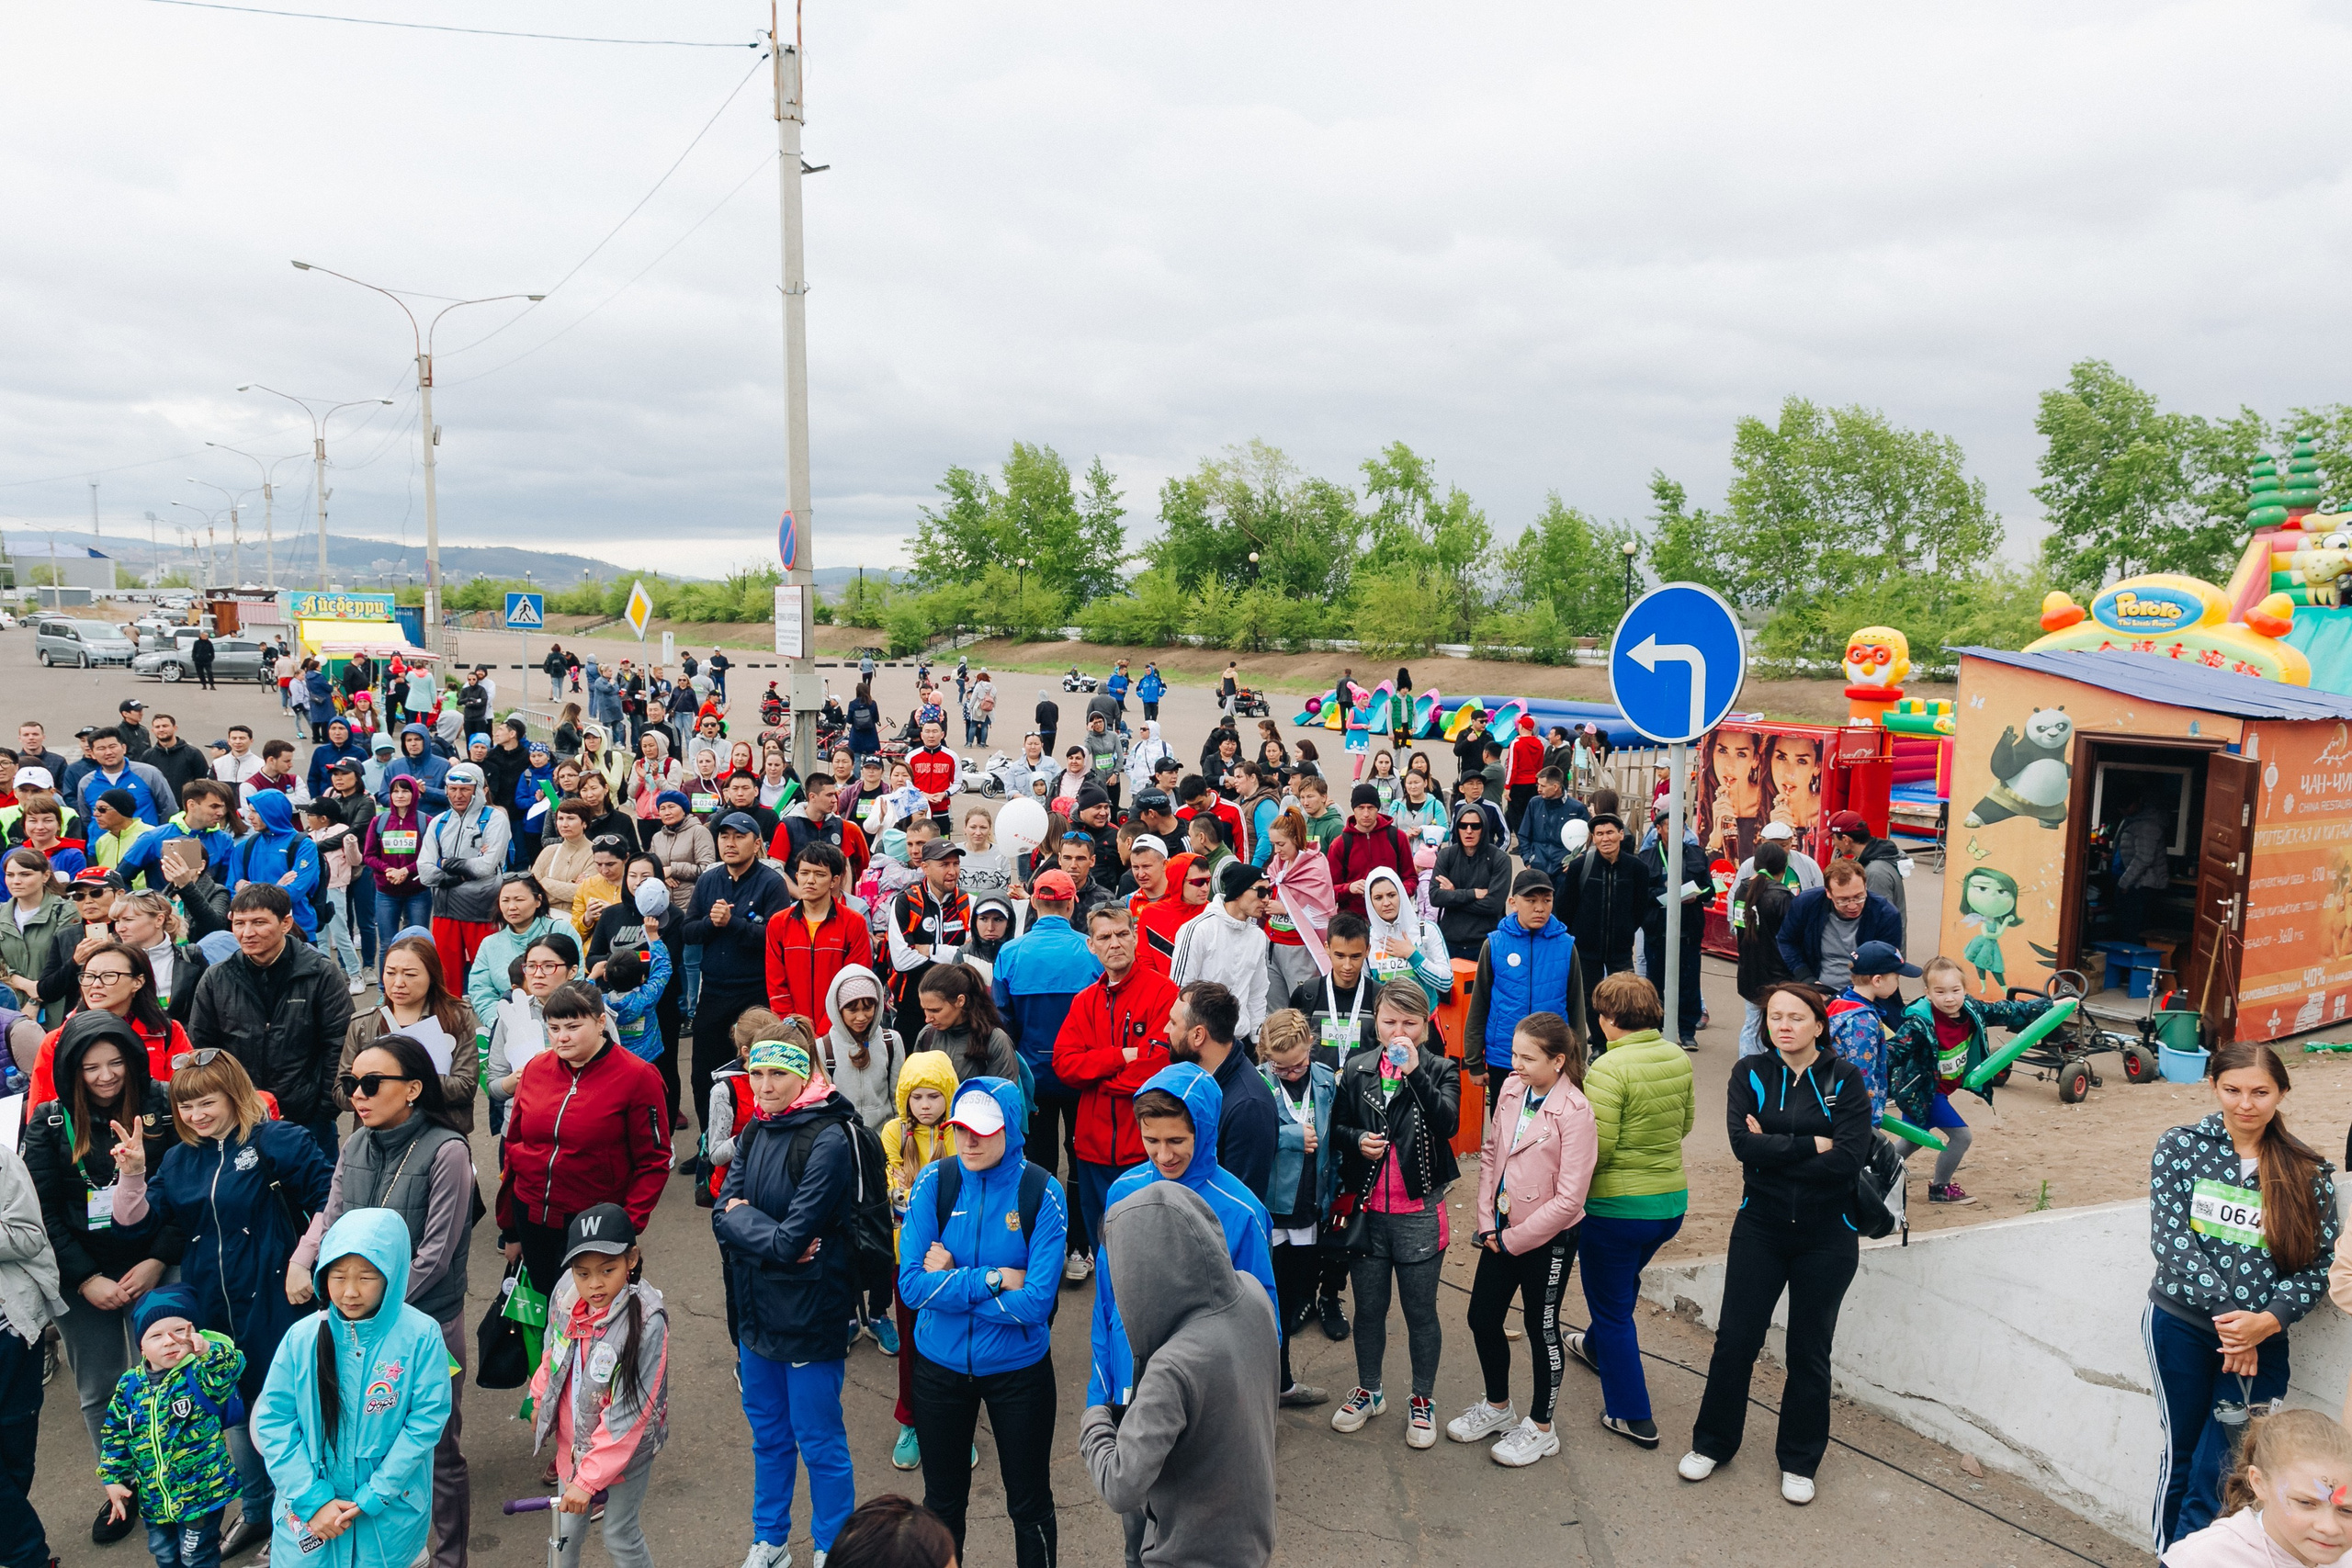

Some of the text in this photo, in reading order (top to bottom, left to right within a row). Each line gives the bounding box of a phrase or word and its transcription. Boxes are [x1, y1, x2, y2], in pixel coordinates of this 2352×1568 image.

[300, 594, 385, 618] Айсберри
[2115, 592, 2184, 620] Pororo
[393, 839, 413, 847] 0158
[2278, 927, 2294, 944] 360
[2303, 966, 2326, 988] 40%
[960, 1094, 992, 1107] RUSSIA
[581, 1215, 603, 1237] W
[1547, 1257, 1564, 1286] READY
[1543, 1304, 1555, 1329] READY
[1546, 1344, 1562, 1371] READY
[367, 1392, 399, 1413] Oops!
[302, 1539, 322, 1551] COOL
